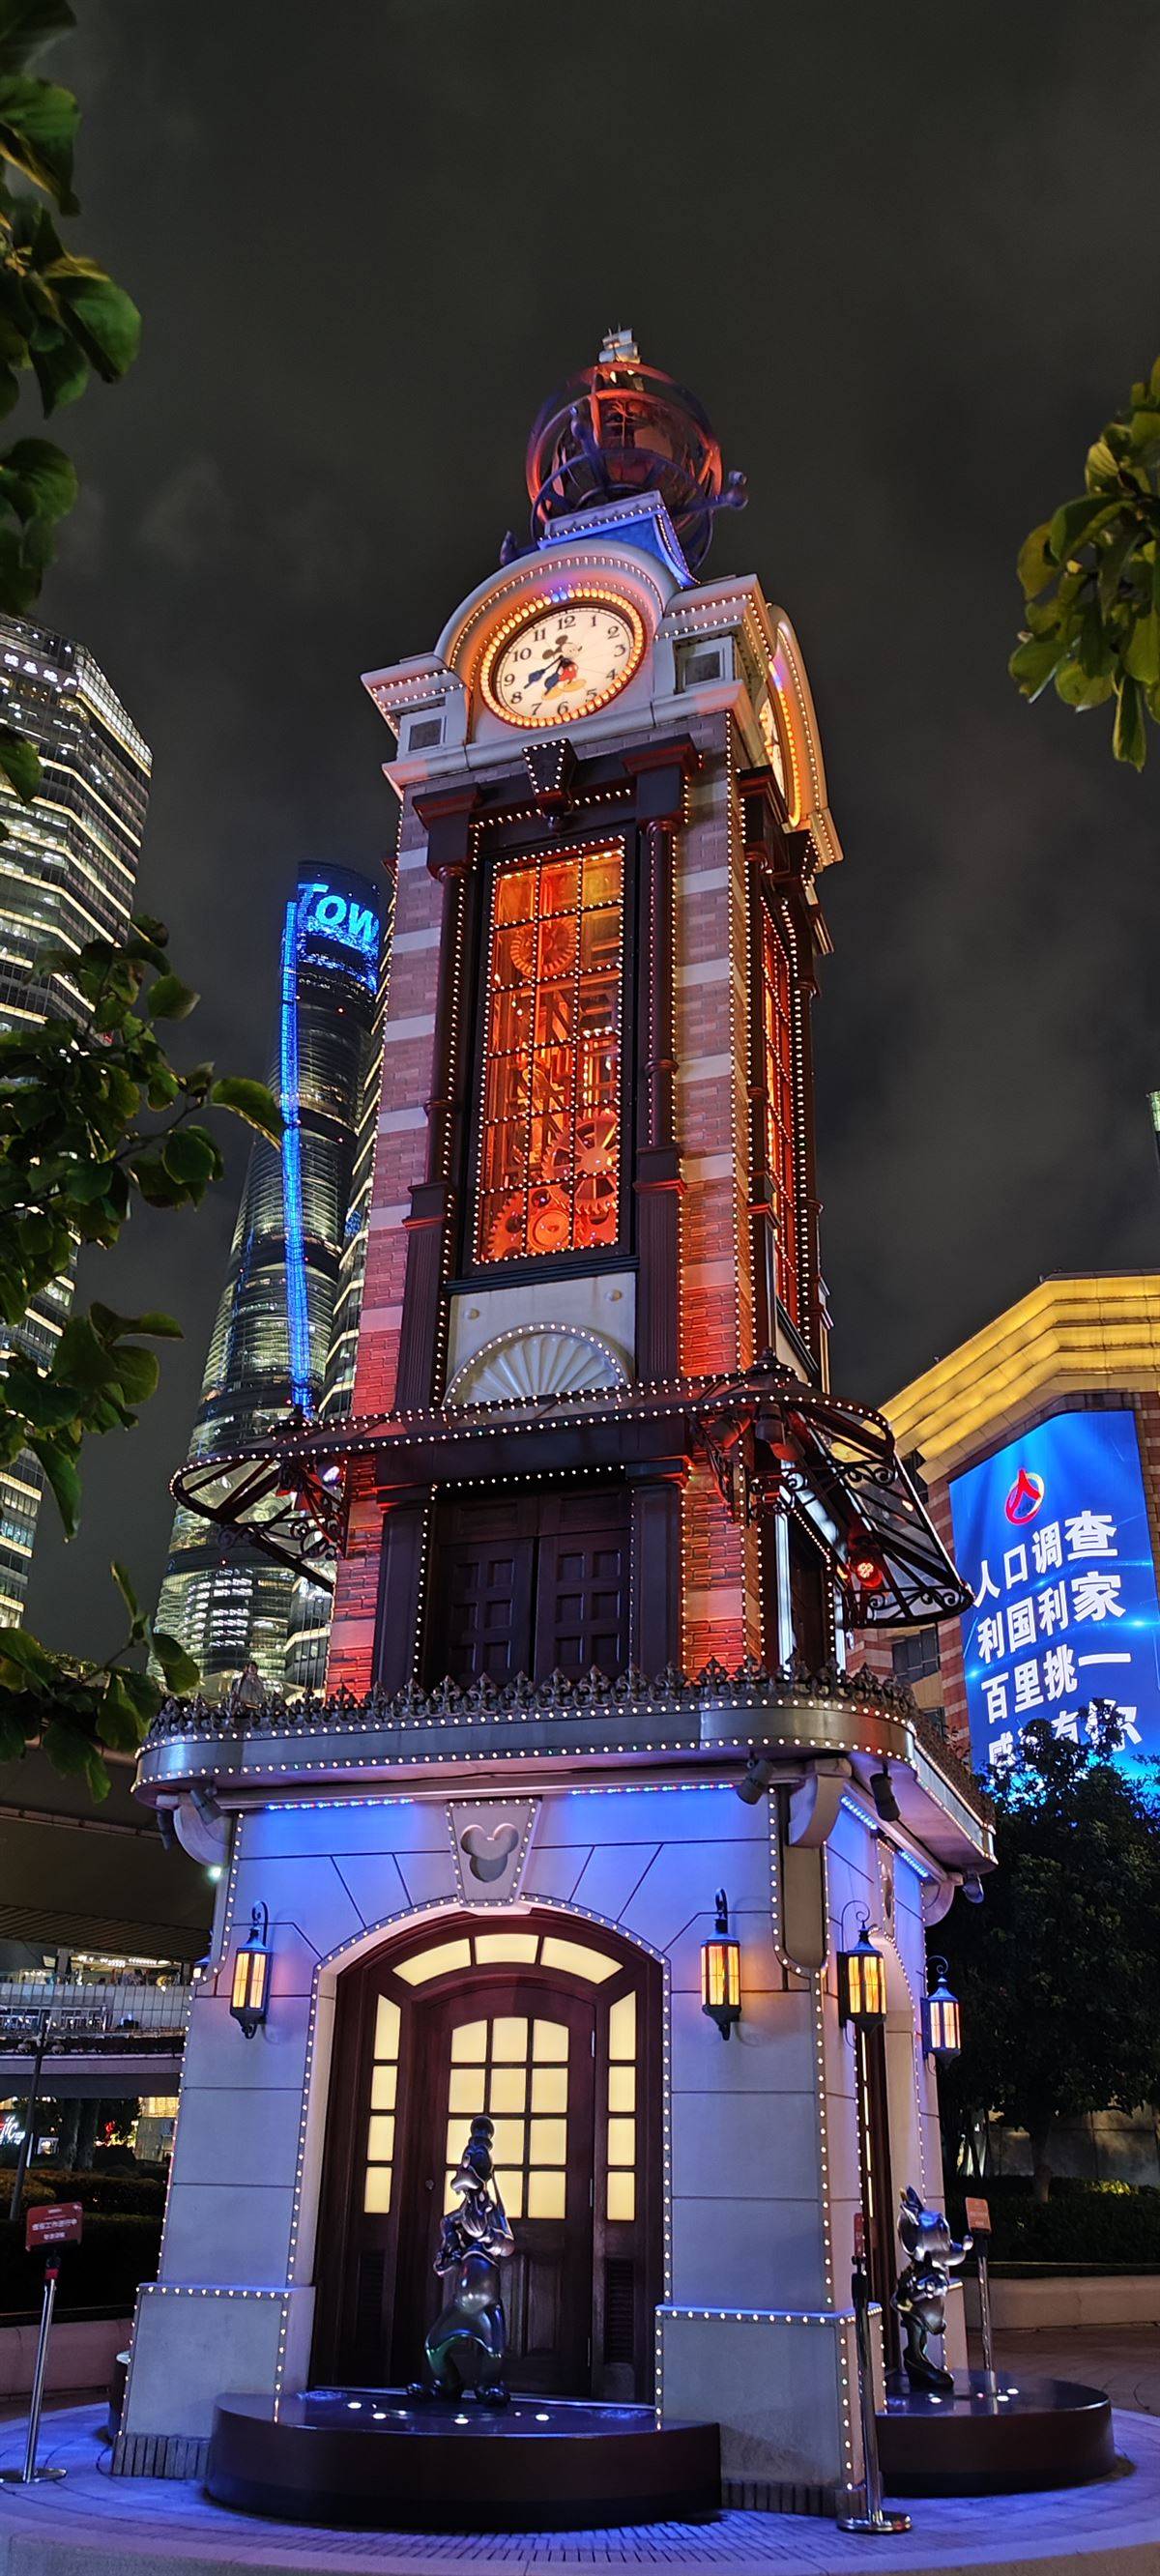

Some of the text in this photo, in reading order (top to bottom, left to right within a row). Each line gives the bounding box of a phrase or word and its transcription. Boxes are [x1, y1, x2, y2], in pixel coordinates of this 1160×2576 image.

[557, 615, 576, 631] 12
[590, 616, 597, 627] 1
[533, 627, 547, 643] 11
[607, 625, 621, 640] 2
[512, 647, 533, 663] 10
[614, 645, 626, 657] 3
[504, 673, 515, 687] 9
[606, 668, 620, 680] 4
[510, 691, 524, 705] 8
[586, 687, 598, 703] 5
[531, 702, 542, 716] 7
[557, 701, 569, 715] 6
[973, 1509, 1118, 1606] 人口调查
[977, 1571, 1126, 1664] 利国利家
[981, 1649, 1132, 1723] 百里挑一
